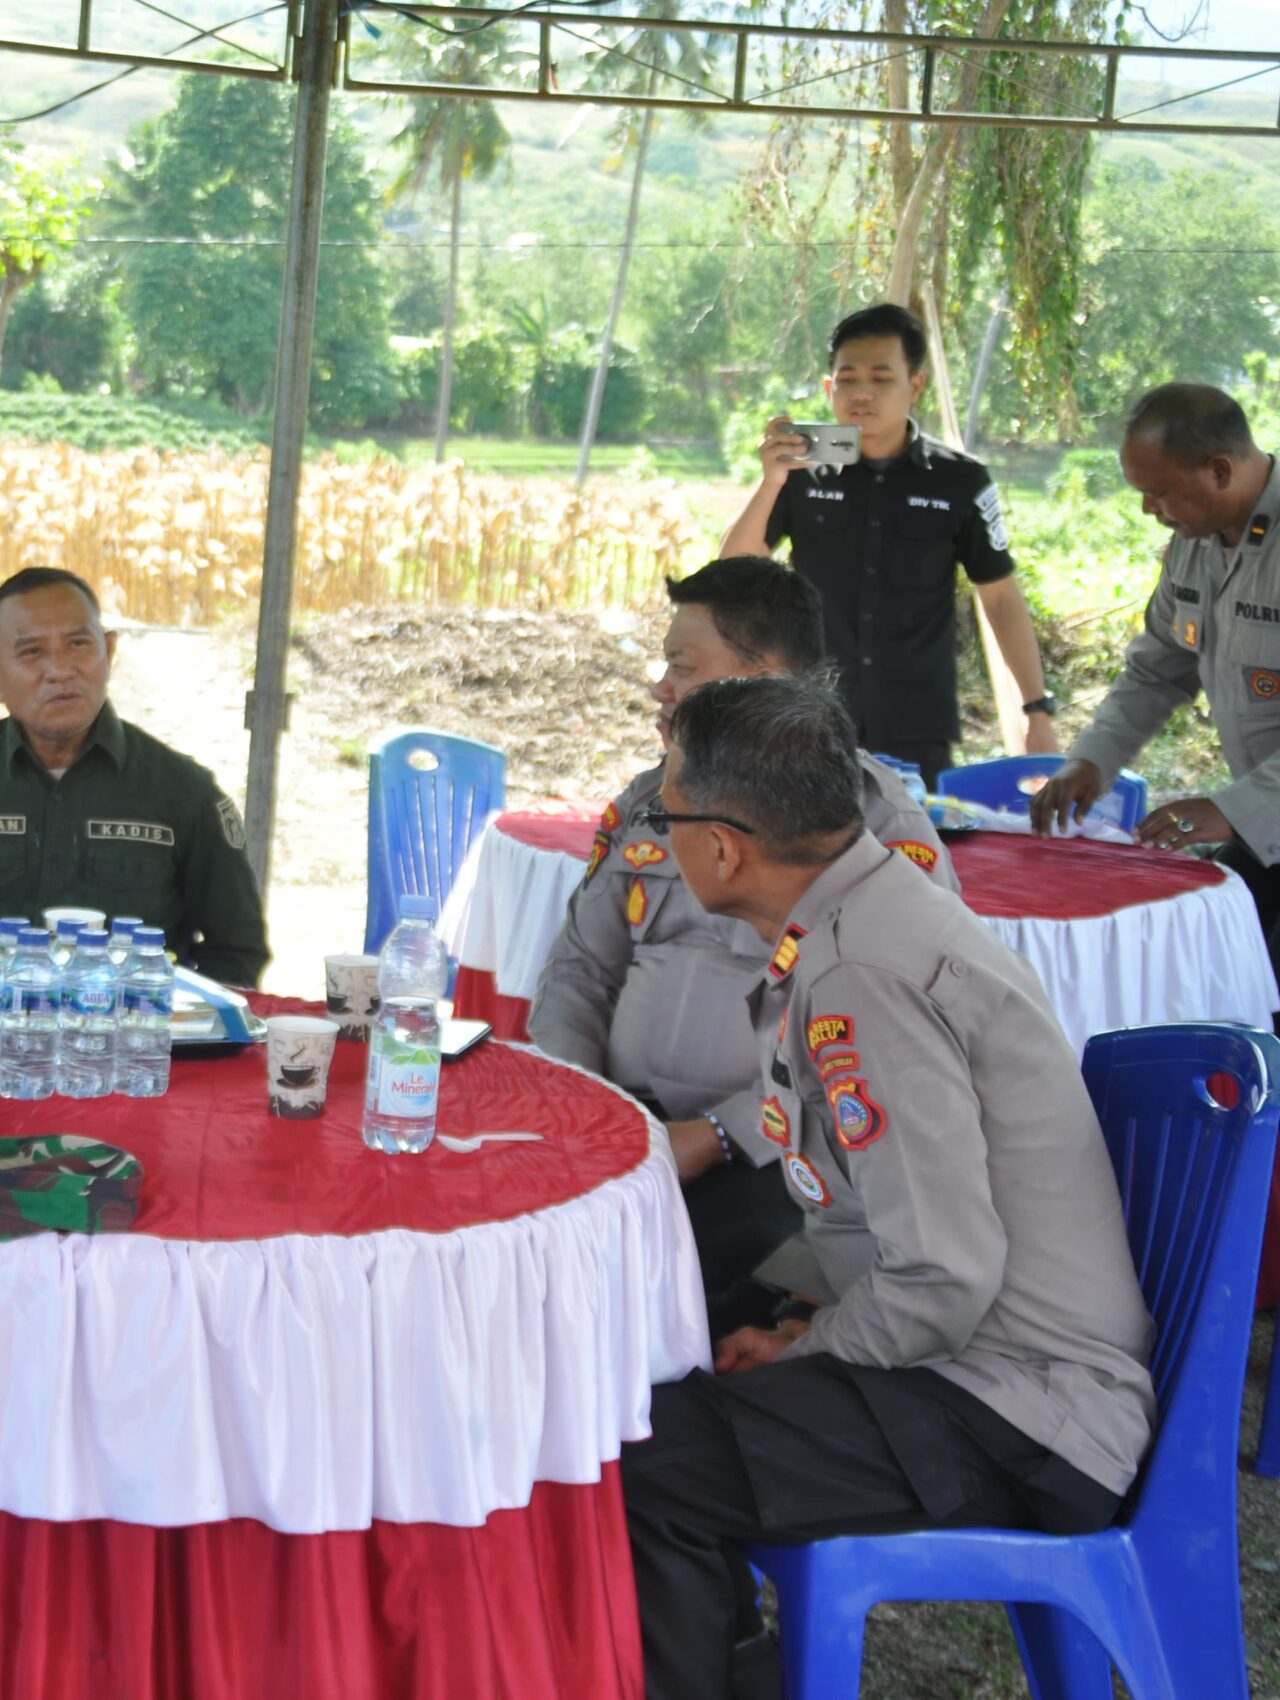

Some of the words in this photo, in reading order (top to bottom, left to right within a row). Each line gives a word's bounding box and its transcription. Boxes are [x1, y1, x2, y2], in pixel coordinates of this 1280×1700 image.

[807, 488, 845, 501] ALAN
[102, 823, 163, 841] KADIS
[410, 1071, 424, 1085] Le
